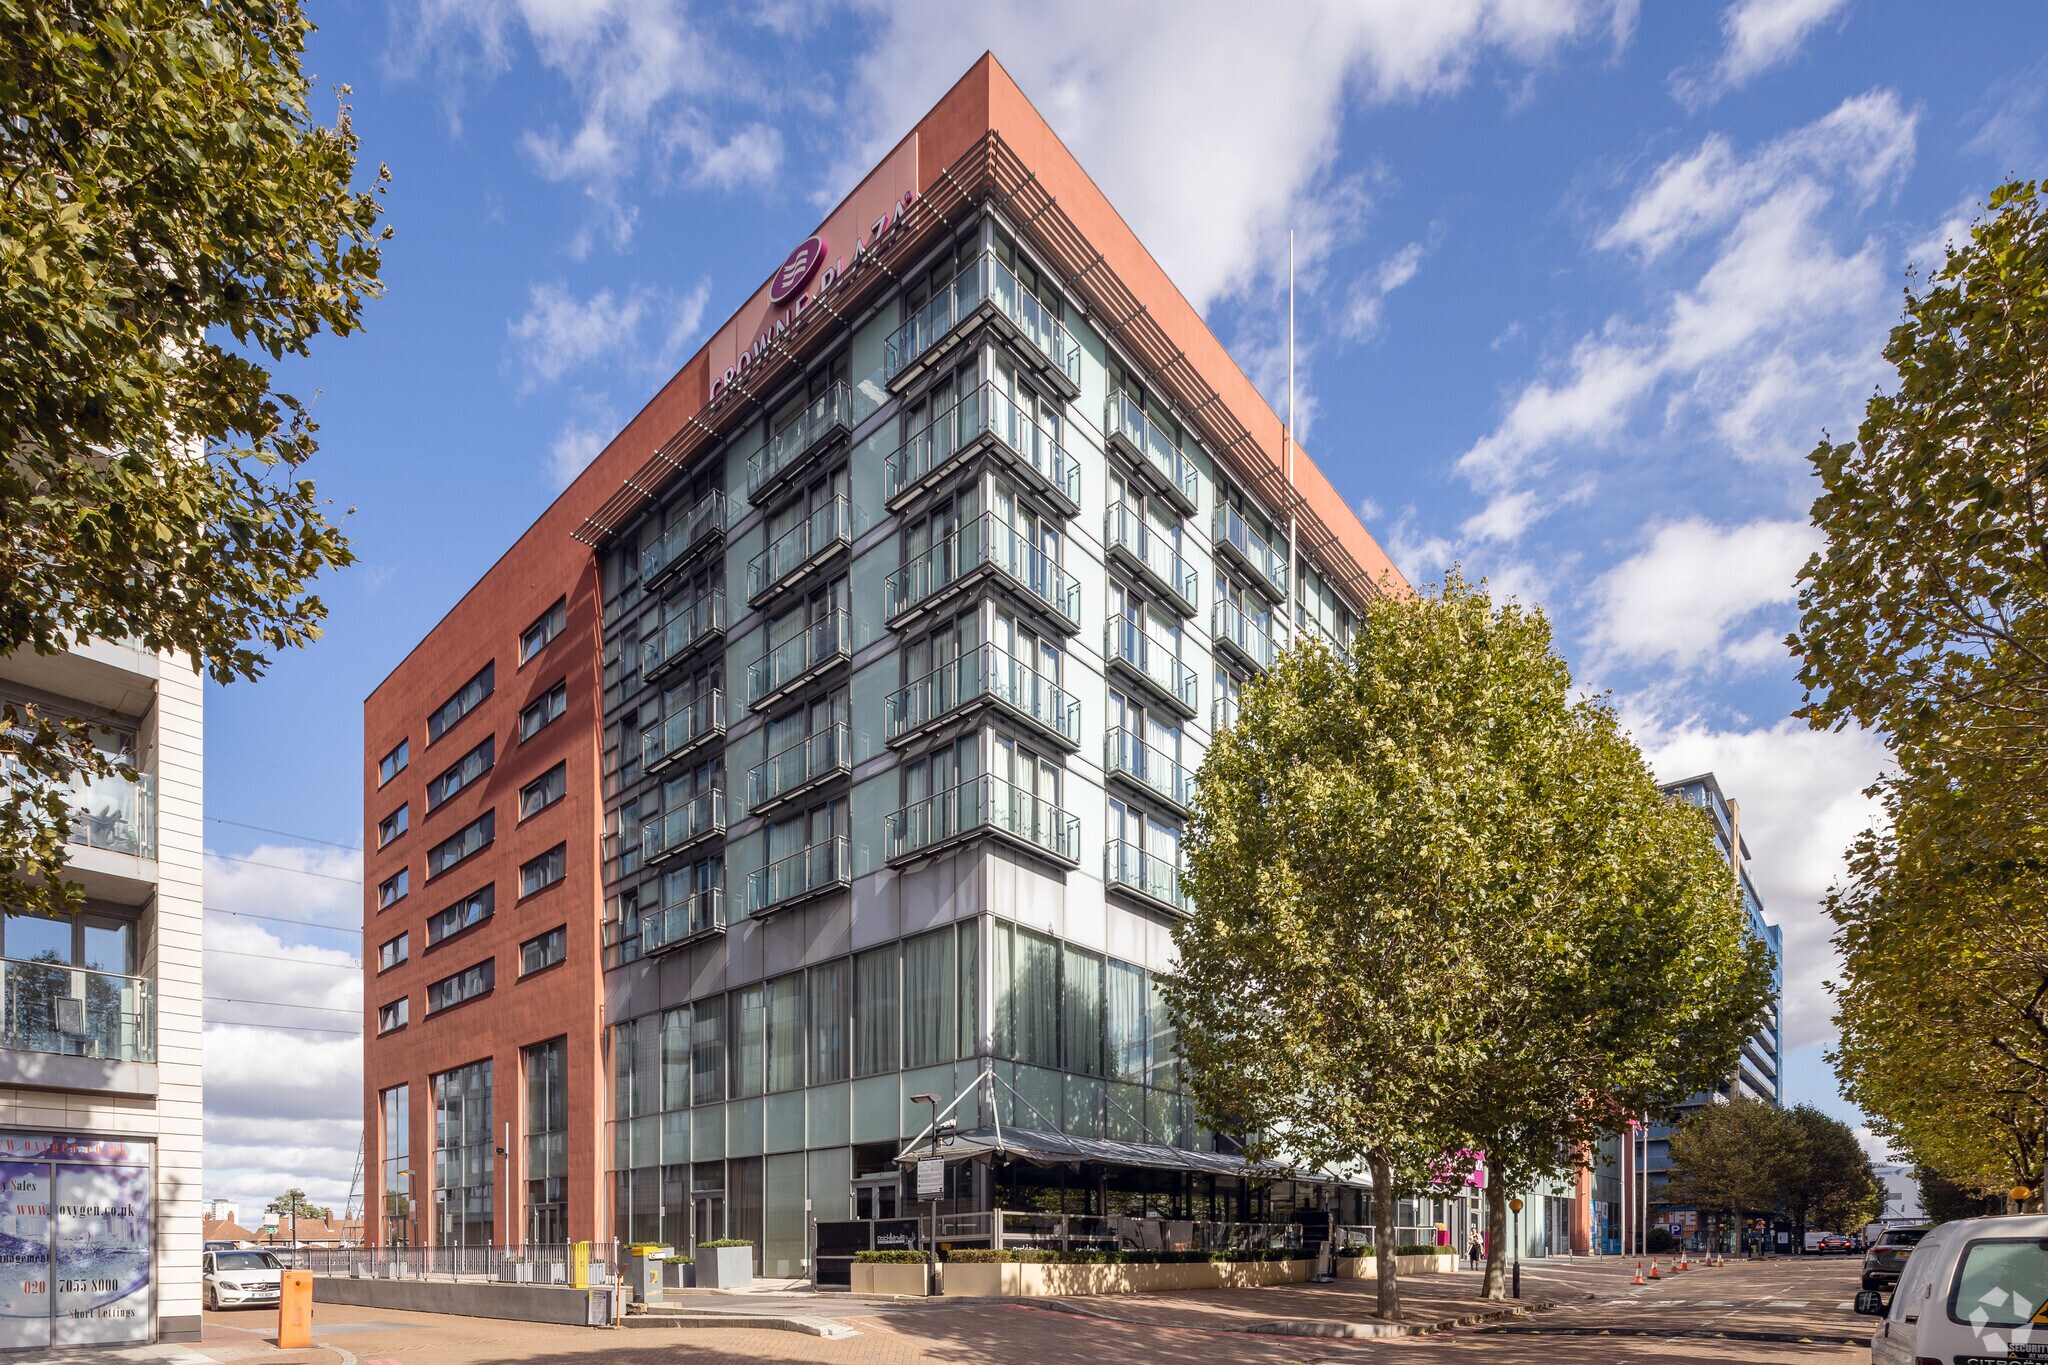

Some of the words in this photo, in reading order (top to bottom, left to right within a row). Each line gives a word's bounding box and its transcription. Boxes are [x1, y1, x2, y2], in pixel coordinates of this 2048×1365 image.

[709, 291, 809, 409] CROWNE
[11, 1179, 37, 1192] Sales
[1671, 1225, 1681, 1235] P
[23, 1280, 46, 1295] 020
[59, 1279, 87, 1293] 7055
[91, 1278, 119, 1292] 8000
[69, 1308, 94, 1320] Short
[97, 1306, 136, 1320] Lettings
